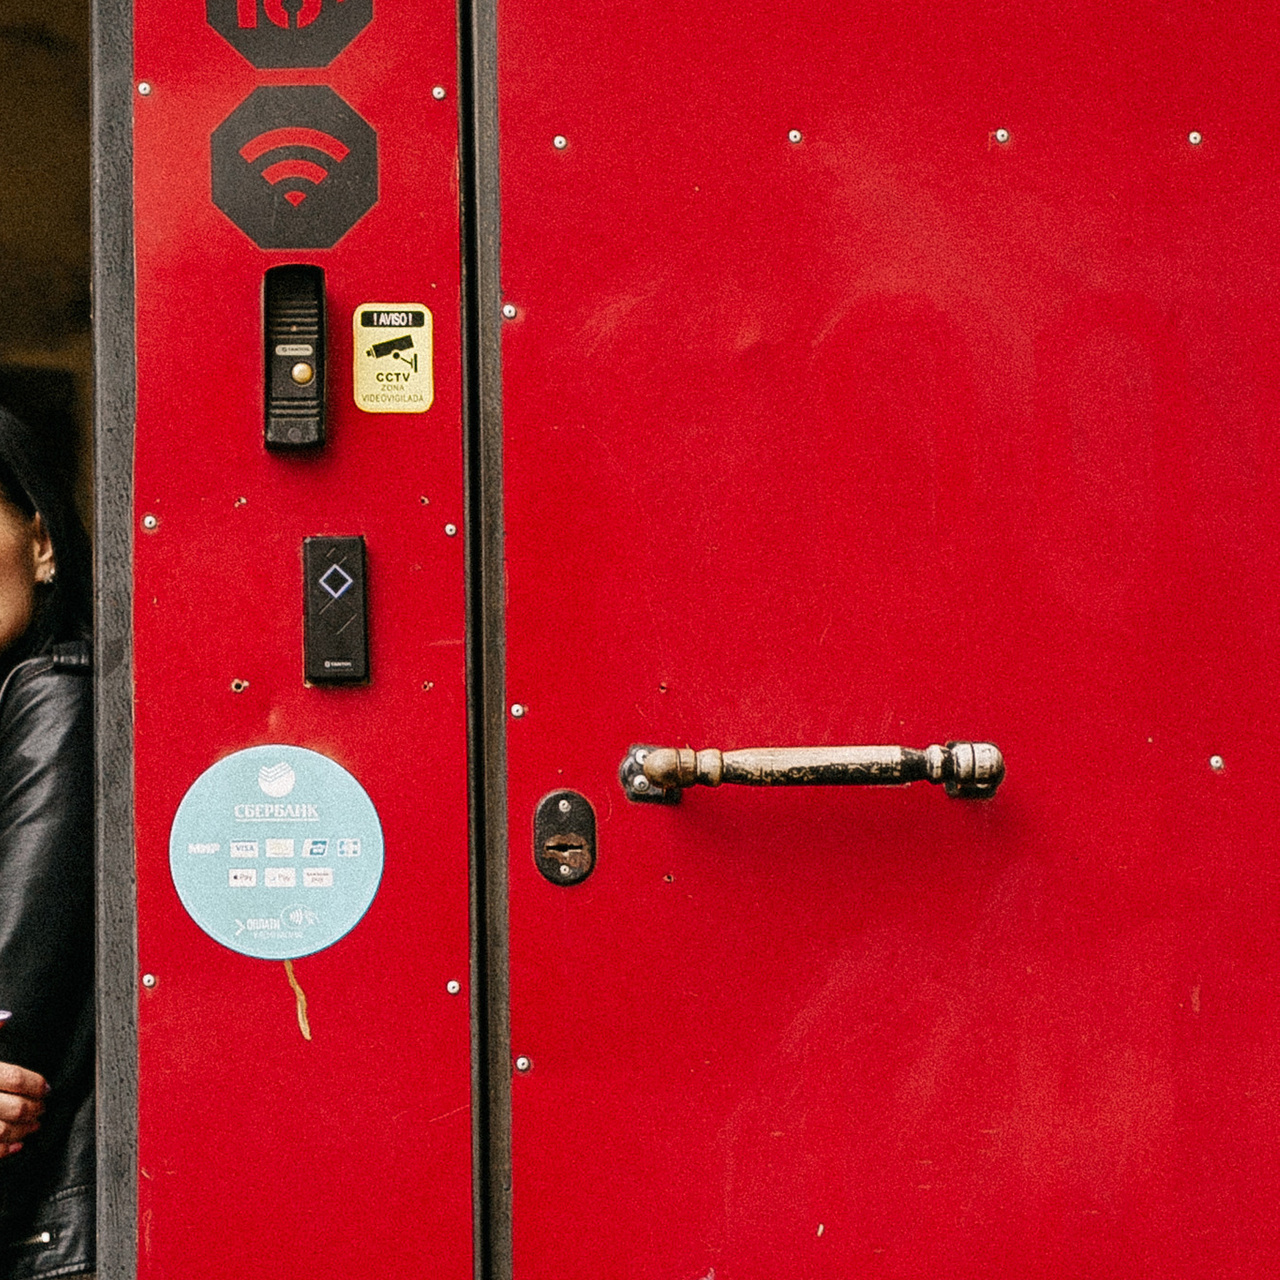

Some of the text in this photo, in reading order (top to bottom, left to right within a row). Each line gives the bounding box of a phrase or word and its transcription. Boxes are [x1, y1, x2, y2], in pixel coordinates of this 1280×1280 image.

[376, 372, 411, 382] CCTV
[361, 394, 424, 403] VIDEOVIGILADA
[233, 803, 319, 819] СБЕРБАНК
[235, 844, 255, 853] VISA
